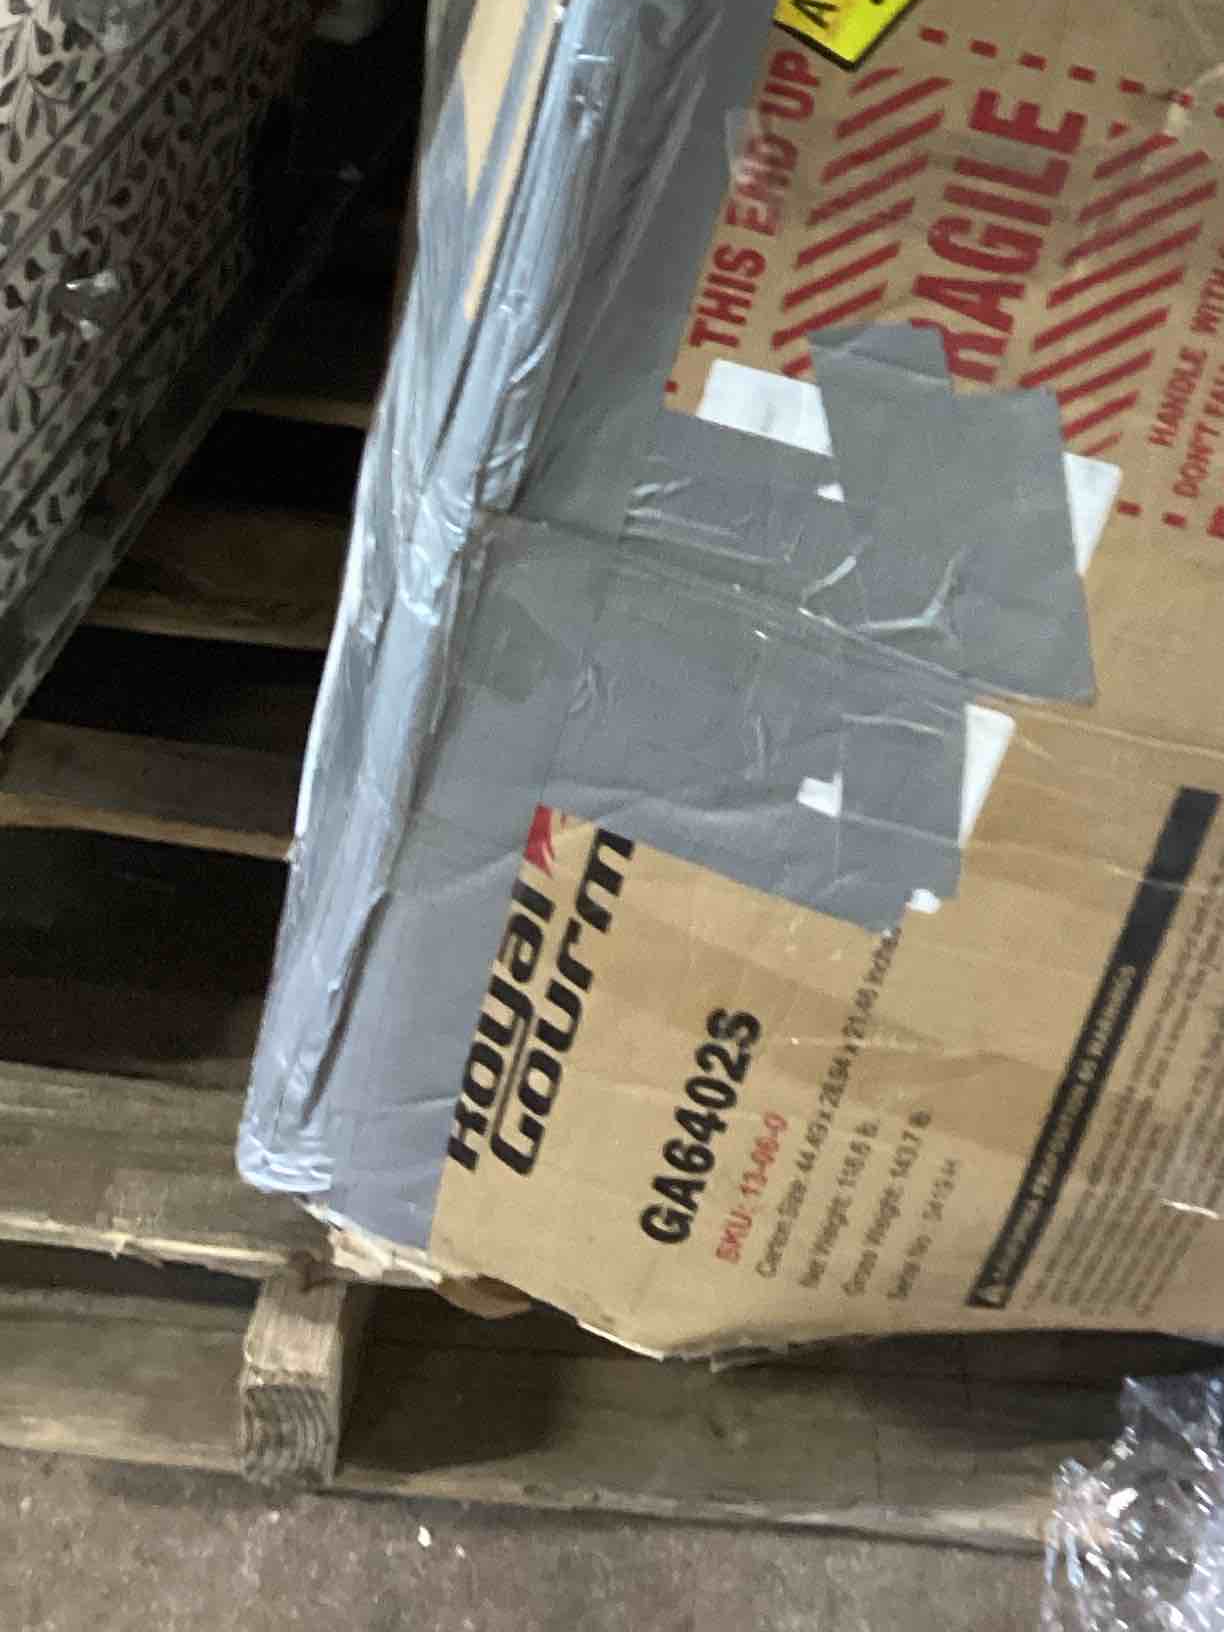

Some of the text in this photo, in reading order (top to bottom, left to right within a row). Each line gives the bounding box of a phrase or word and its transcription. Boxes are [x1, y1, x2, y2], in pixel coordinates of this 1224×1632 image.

[690, 49, 822, 355] THIS END UP
[911, 86, 1088, 384] RAGILE
[1149, 345, 1209, 448] HANDLE
[447, 878, 555, 1174] Royal
[490, 828, 636, 1177] Gourm
[639, 1007, 761, 1244] GA6402S
